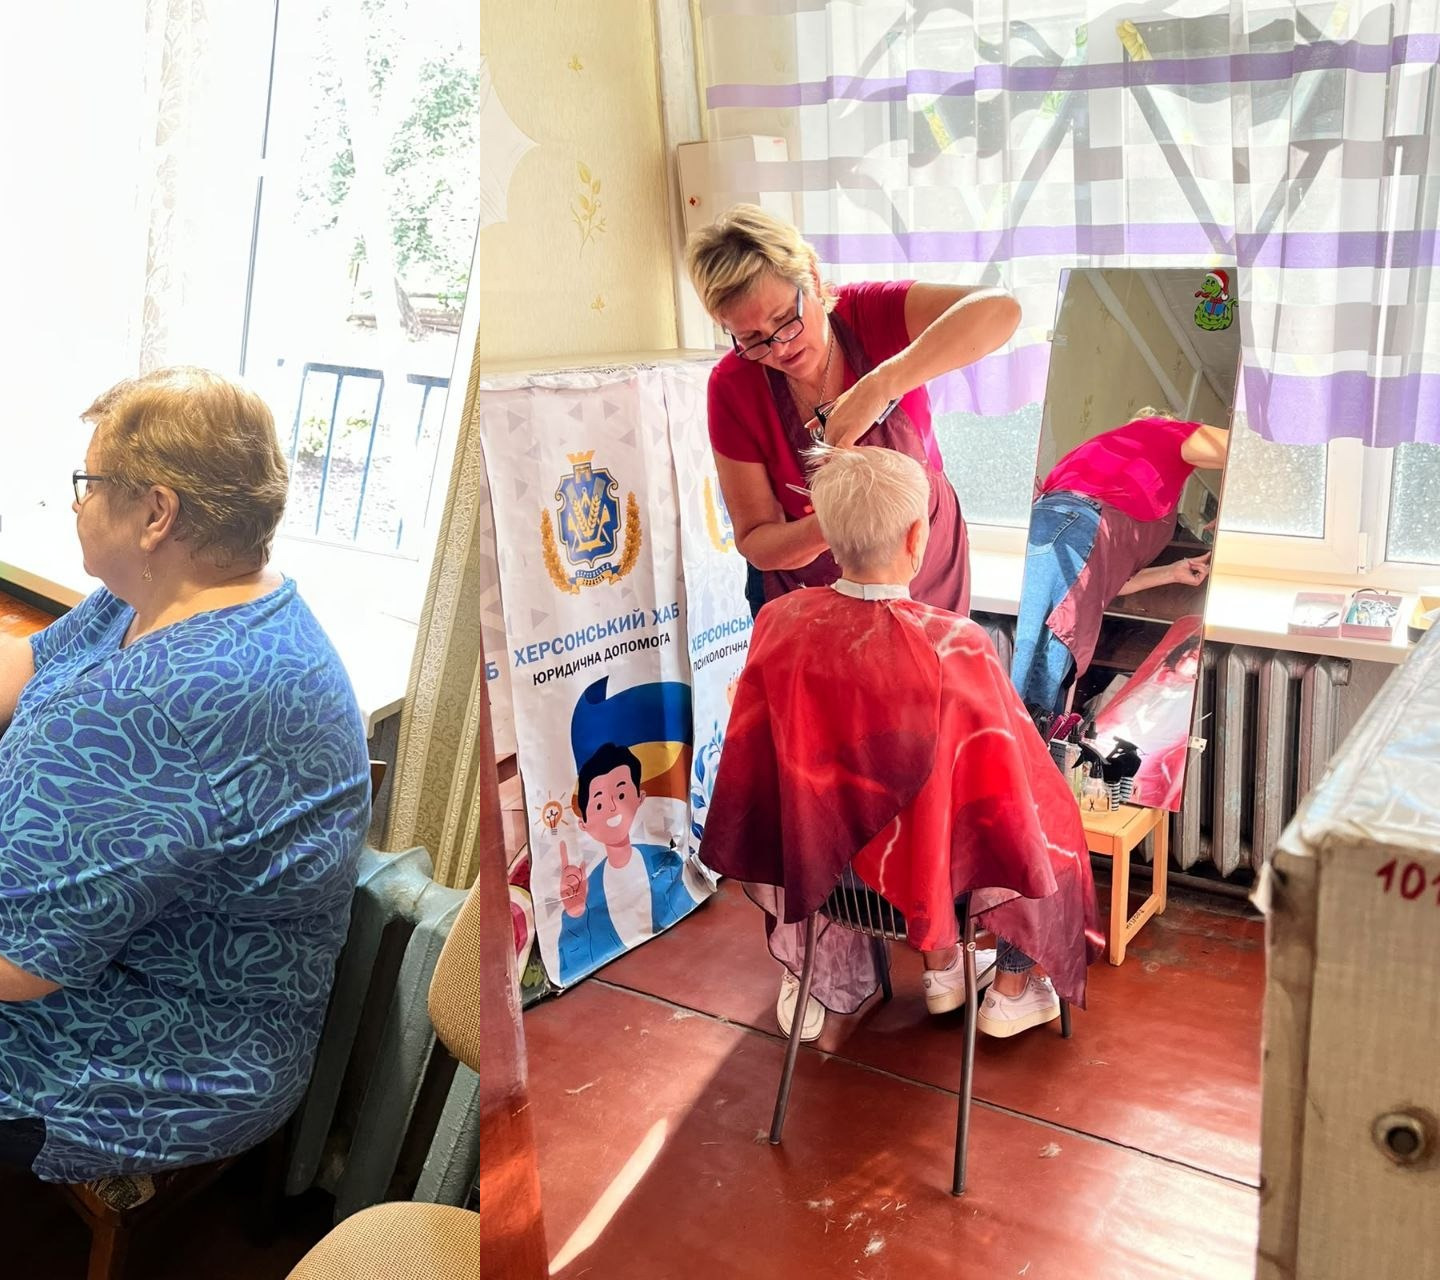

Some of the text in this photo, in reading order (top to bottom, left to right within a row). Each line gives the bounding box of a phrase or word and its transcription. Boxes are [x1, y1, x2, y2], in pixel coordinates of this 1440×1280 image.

[513, 602, 681, 668] ХЕРСОНСЬКИЙ ХАБ
[691, 615, 753, 654] ХЕРСОНСЬК
[693, 639, 749, 672] ПСИХОЛОГІЧНА
[533, 653, 602, 686] ЮРИДИЧНА
[604, 632, 671, 663] ДОПОМОГА
